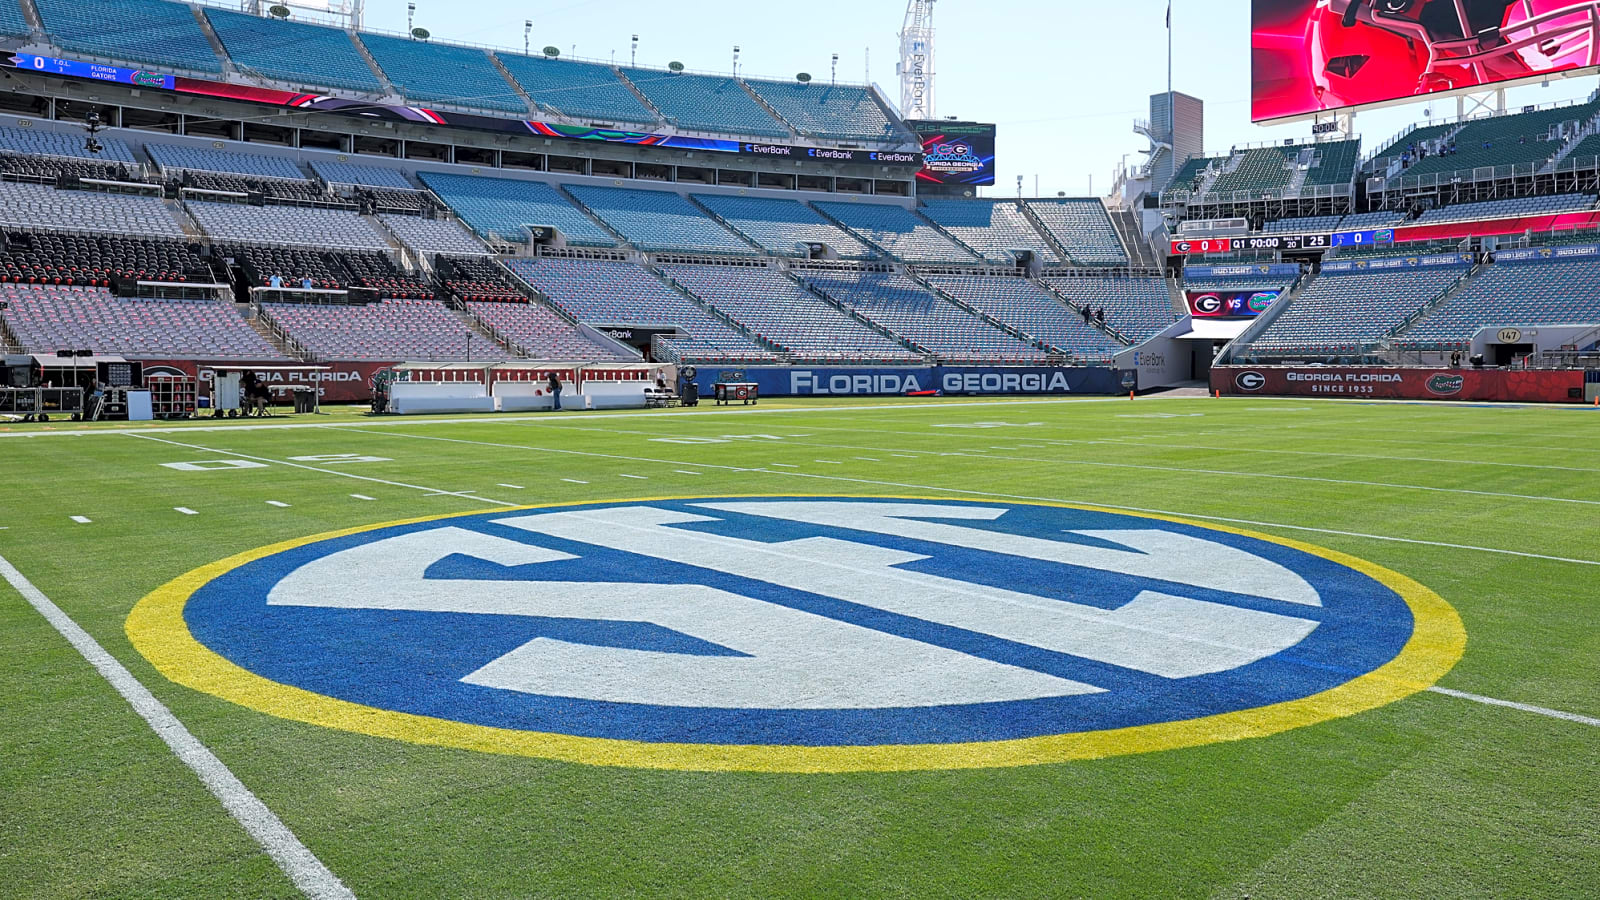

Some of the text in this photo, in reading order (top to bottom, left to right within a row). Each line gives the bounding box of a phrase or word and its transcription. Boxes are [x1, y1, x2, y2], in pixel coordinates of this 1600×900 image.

[34, 56, 44, 69] 0
[90, 65, 117, 74] FLORIDA
[91, 72, 116, 80] GATORS
[914, 54, 925, 113] EverBank
[753, 145, 790, 155] EverBank
[816, 149, 852, 159] EverBank
[878, 152, 914, 162] EverBank
[1309, 236, 1324, 246] 25
[1354, 233, 1362, 242] 0
[1201, 241, 1209, 251] 0
[1233, 240, 1245, 249] Q1
[1250, 238, 1279, 249] 90:00
[1287, 241, 1297, 249] 20
[1228, 299, 1241, 308] VS
[604, 329, 632, 339] erBank
[1501, 331, 1517, 340] 147
[1140, 352, 1165, 366] EverBank
[200, 370, 362, 382] GGIA FLORIDA
[1286, 372, 1403, 382] GEORGIA FLORIDA
[790, 371, 1070, 394] FLORIDA GEORGIA
[1312, 384, 1374, 393] SINCE 1933
[266, 499, 1322, 710] SEC
